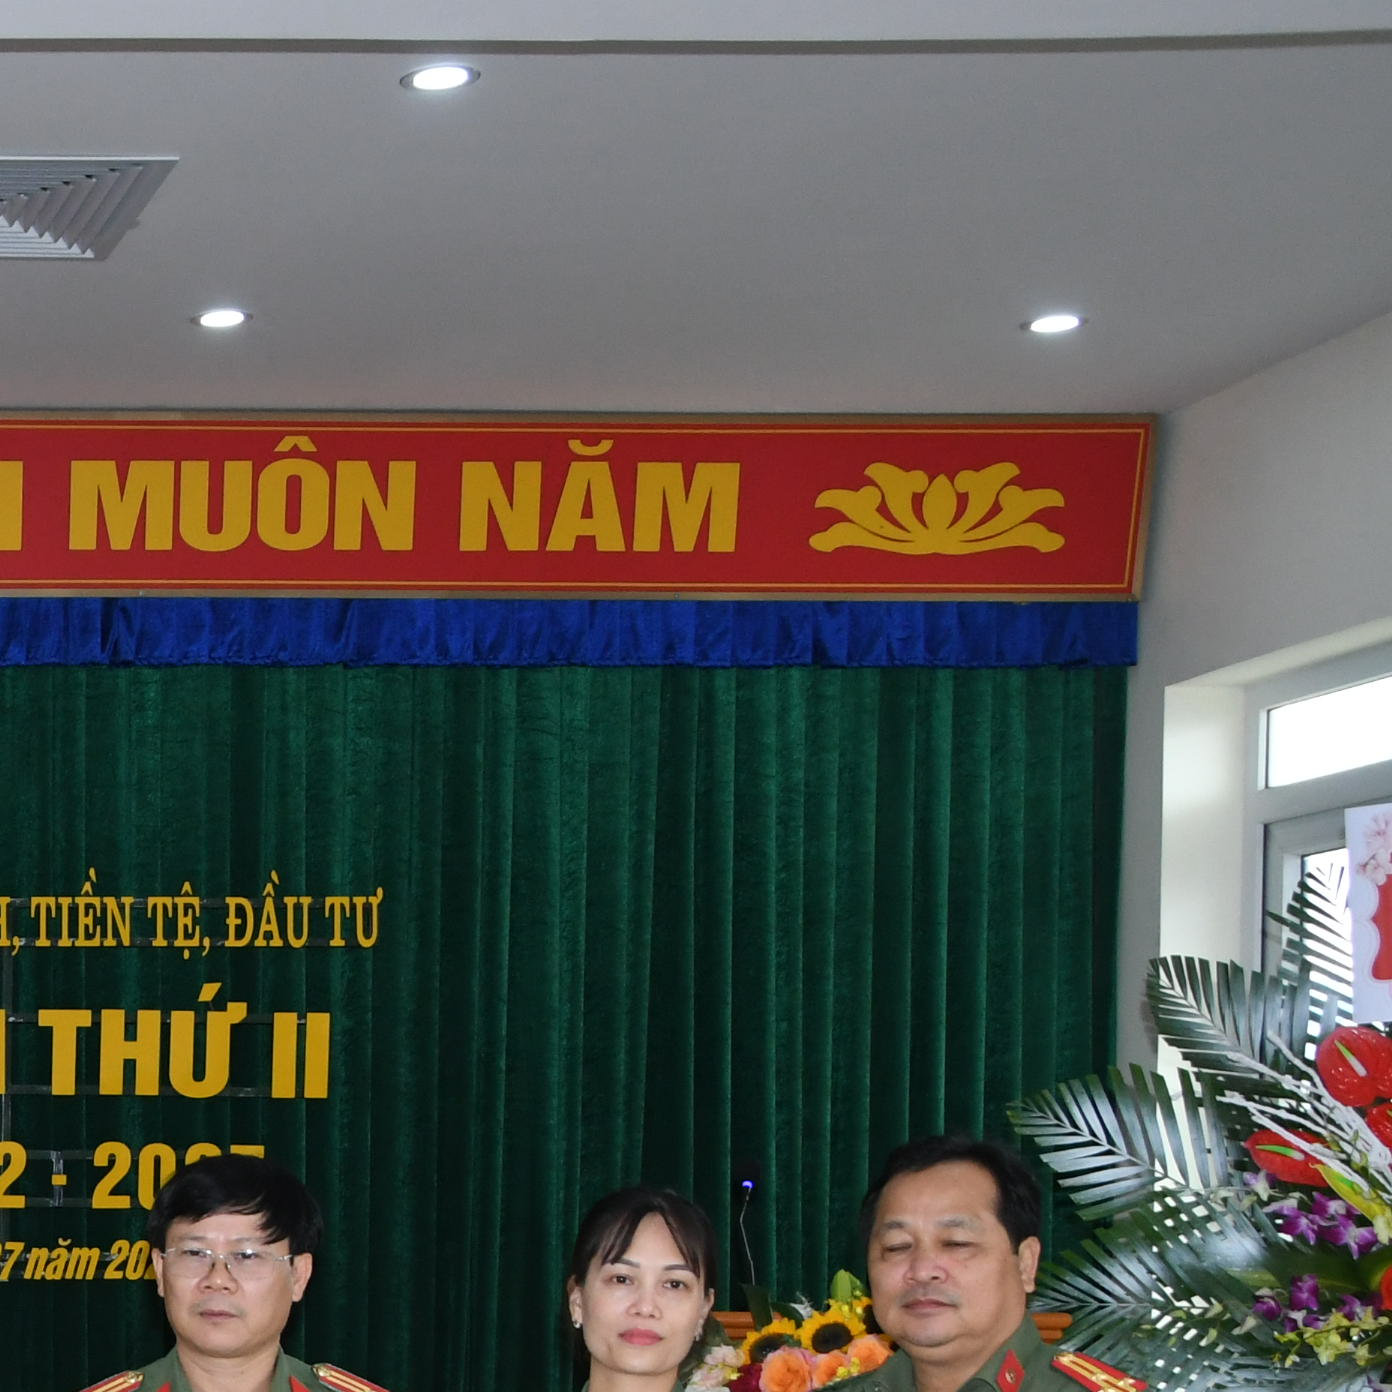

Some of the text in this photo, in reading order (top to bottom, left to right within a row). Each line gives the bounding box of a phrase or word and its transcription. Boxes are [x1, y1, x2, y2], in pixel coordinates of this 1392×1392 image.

[70, 436, 417, 552] MUÔN
[460, 439, 741, 553] NĂM
[30, 867, 135, 947] TIỀN
[147, 881, 211, 960] TỆ,
[224, 870, 313, 949] ĐẦU
[324, 887, 385, 949] TƯ
[37, 982, 248, 1099] THỨ
[271, 1012, 331, 1099] II
[51, 1173, 67, 1186] -
[91, 1141, 266, 1211] 20
[24, 1238, 101, 1281] năm
